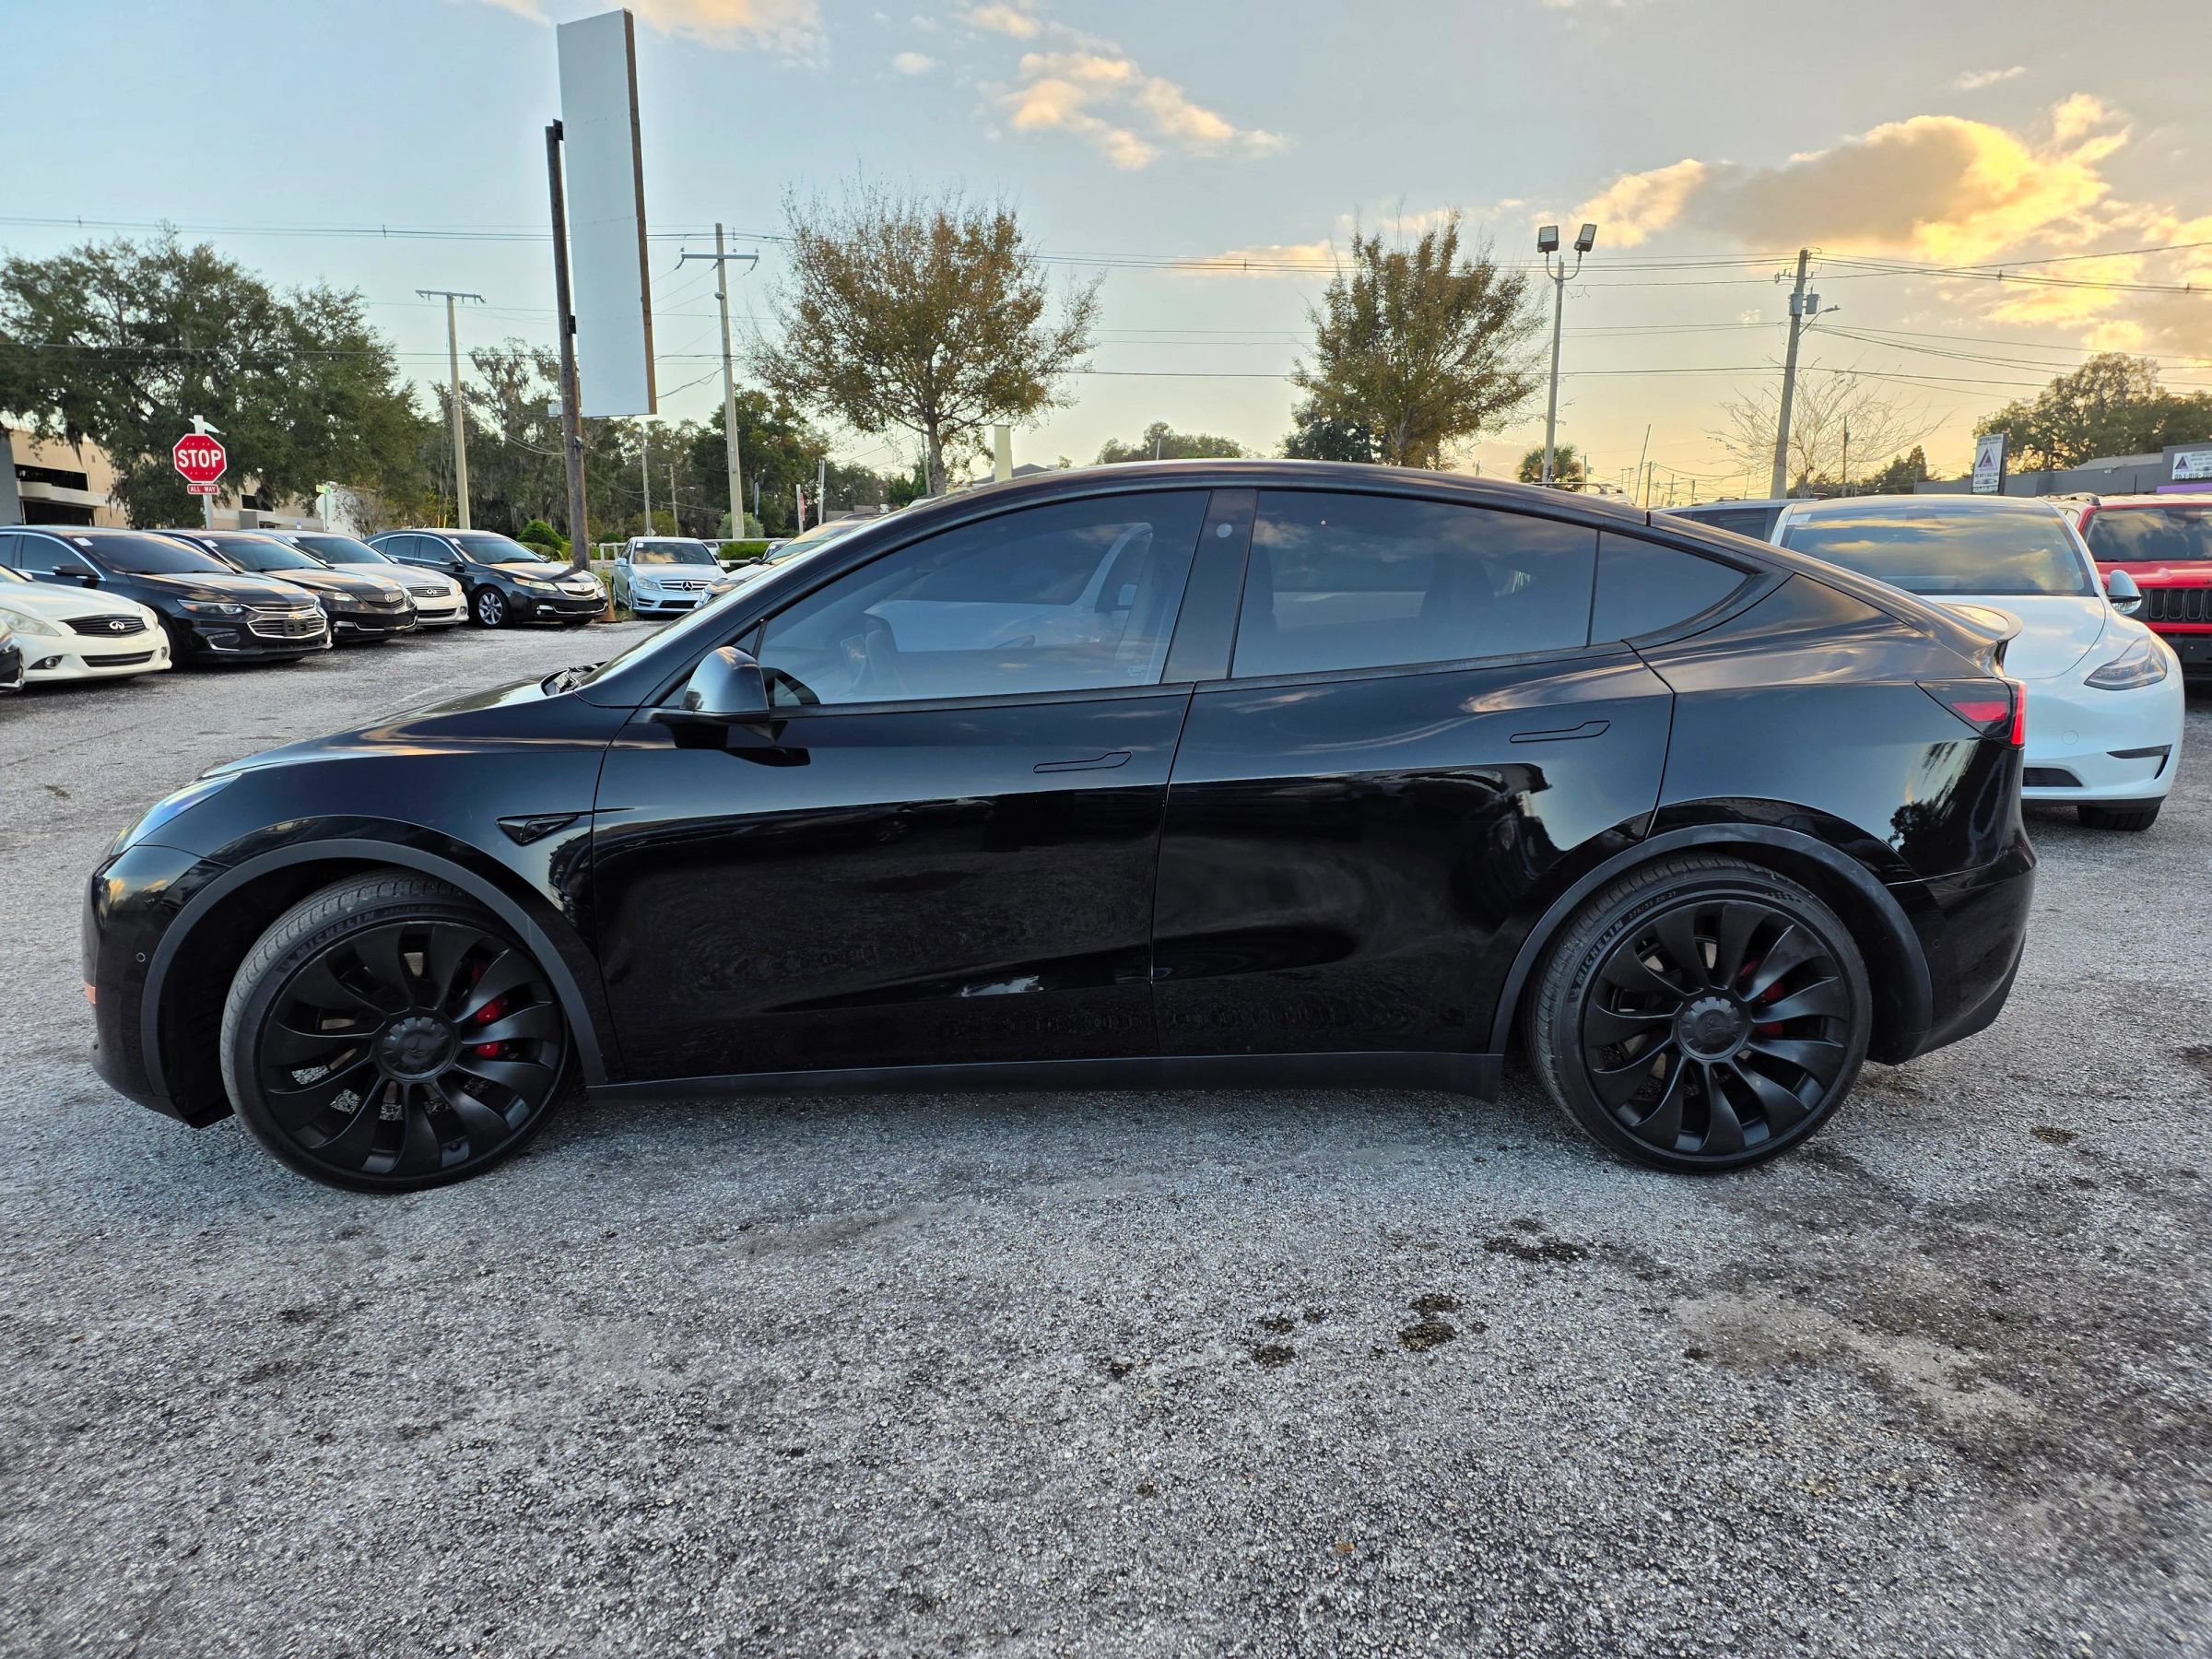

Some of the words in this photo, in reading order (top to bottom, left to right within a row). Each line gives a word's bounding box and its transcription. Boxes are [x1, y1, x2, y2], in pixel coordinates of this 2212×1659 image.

[177, 449, 221, 468] STOP
[295, 911, 376, 959] MICHELIN
[1575, 919, 1624, 985] MICHELIN
[1628, 901, 1653, 920] 275/35
[1655, 894, 1666, 903] ZR
